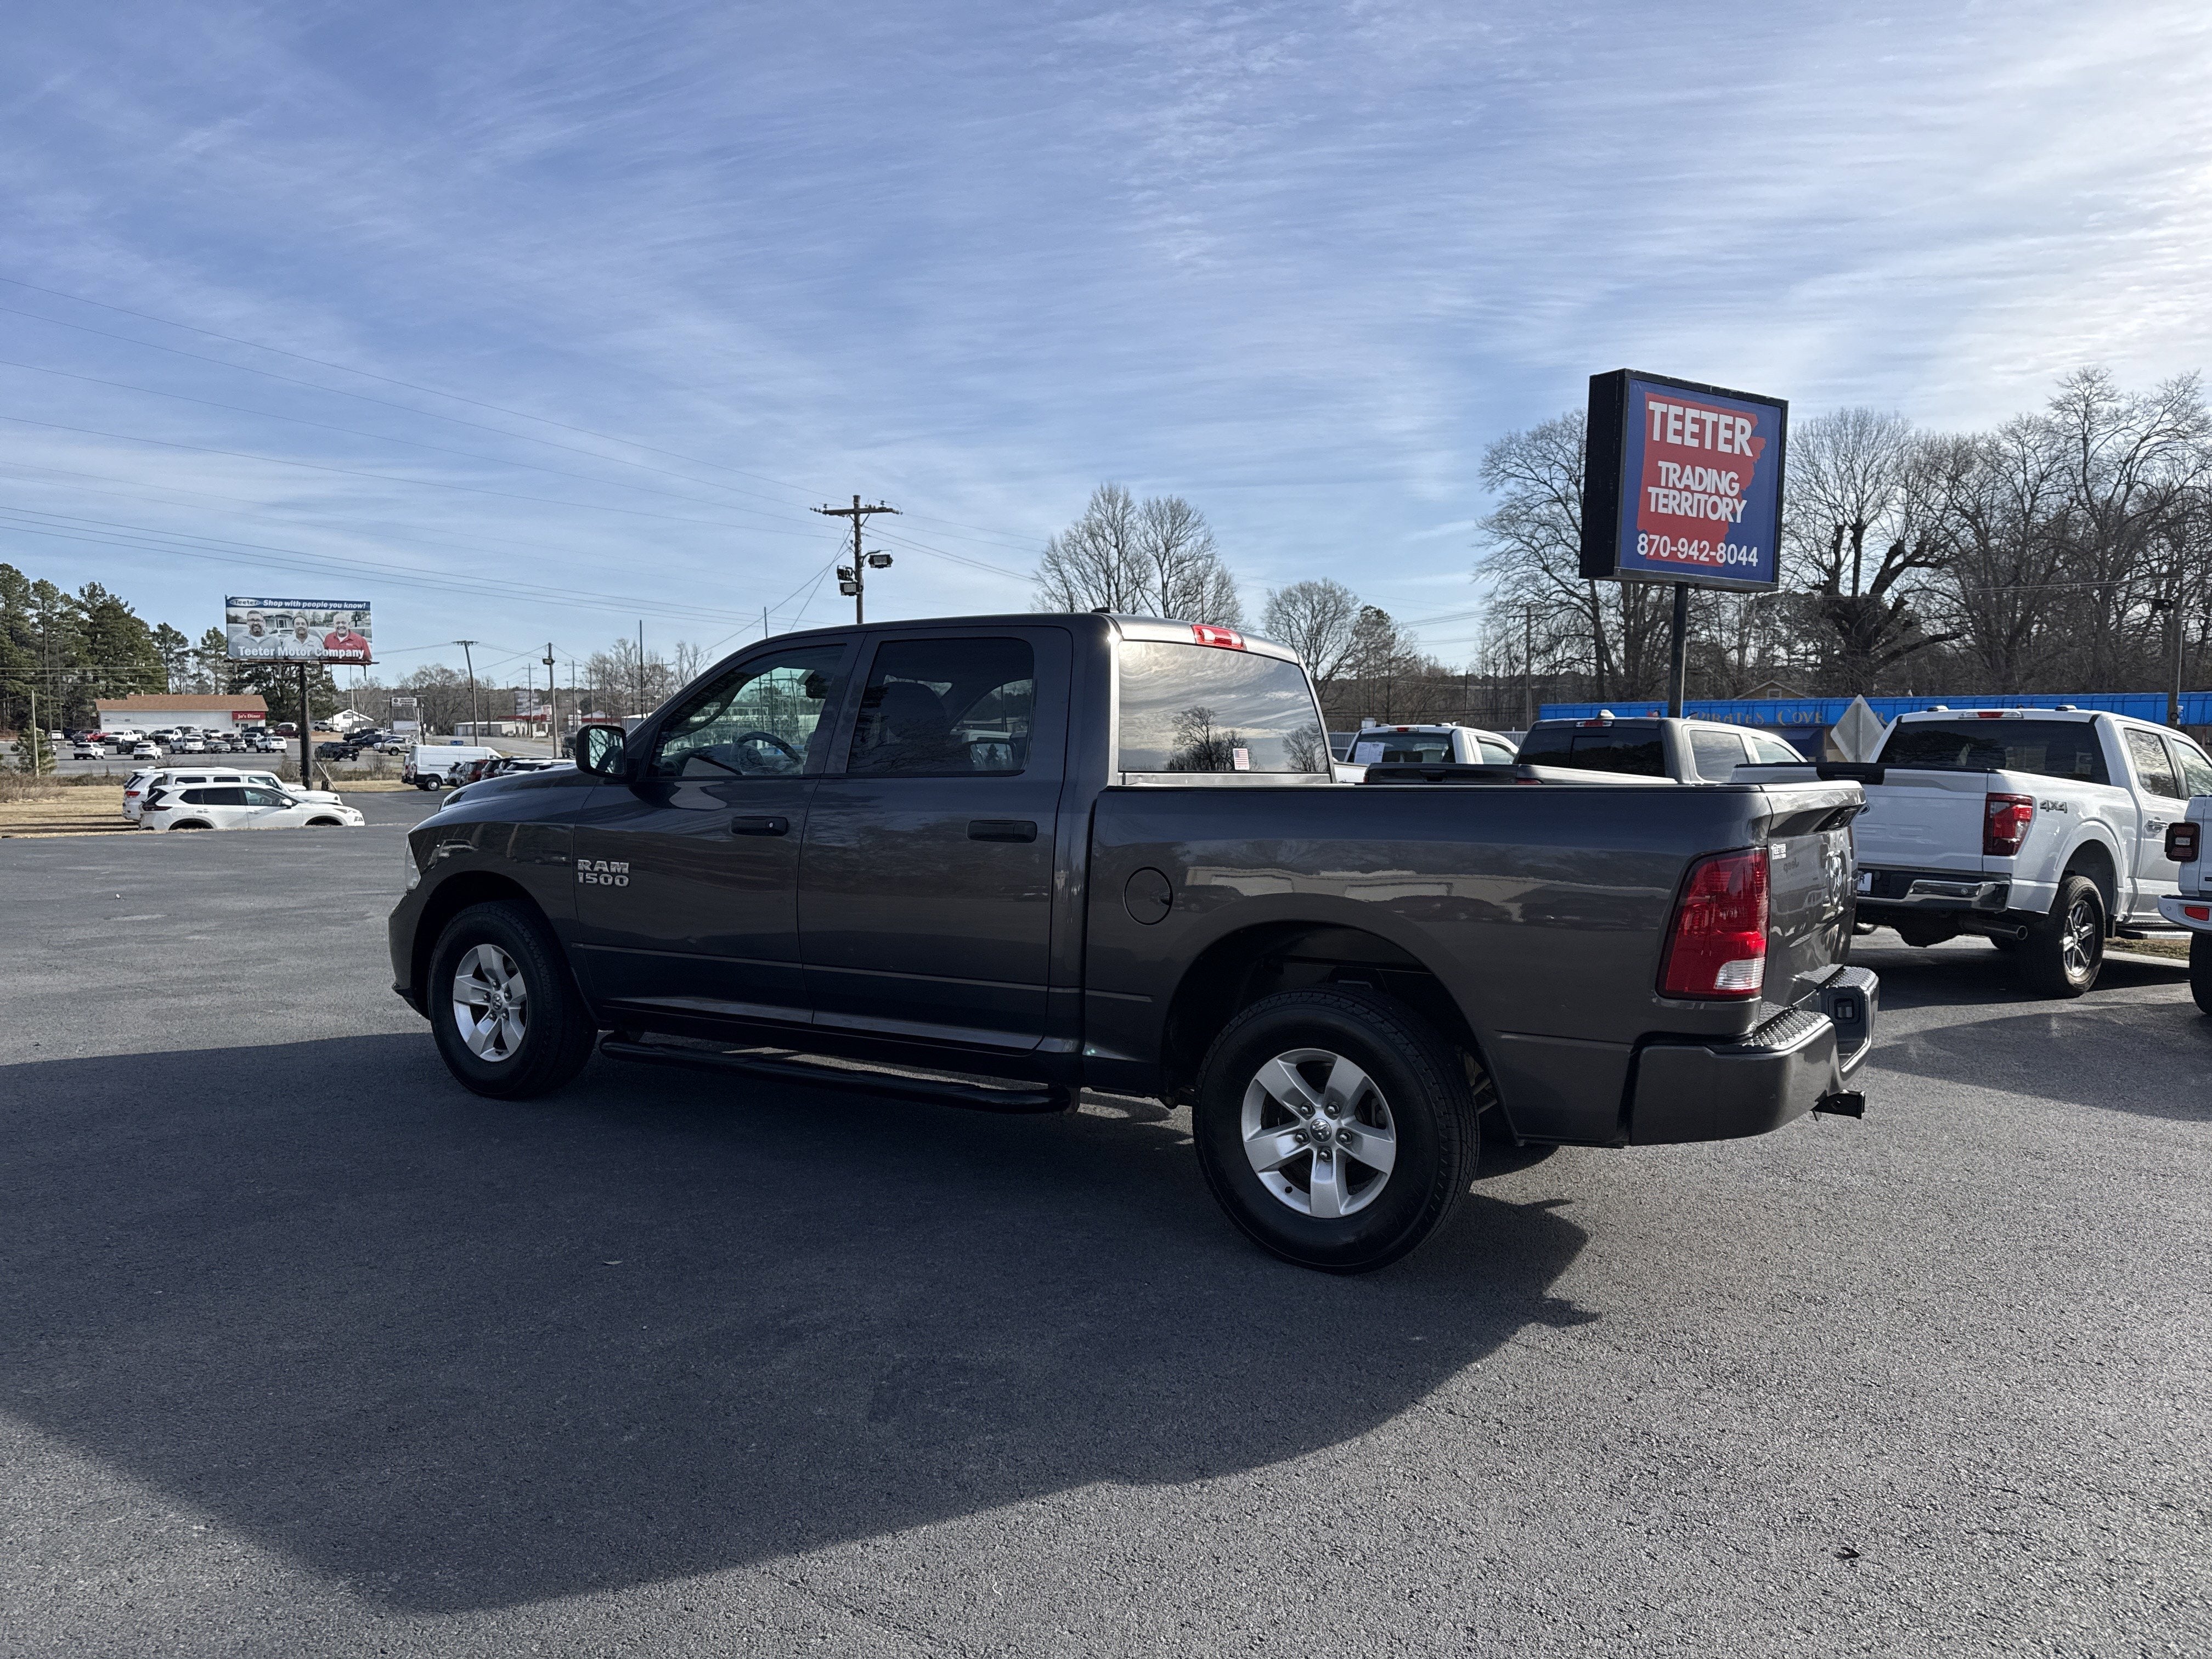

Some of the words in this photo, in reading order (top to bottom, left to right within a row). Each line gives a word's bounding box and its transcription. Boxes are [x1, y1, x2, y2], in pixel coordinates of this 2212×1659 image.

[1649, 400, 1753, 457] TEETER
[1658, 460, 1740, 496] TRADING
[1647, 486, 1747, 523] TERRITORY
[1637, 533, 1758, 567] 870-942-8044
[263, 599, 283, 608] Shop
[238, 646, 275, 656] Teeter
[278, 646, 311, 657] Motor
[314, 647, 365, 659] Company
[578, 859, 629, 873] RAM
[578, 872, 629, 887] 1500
